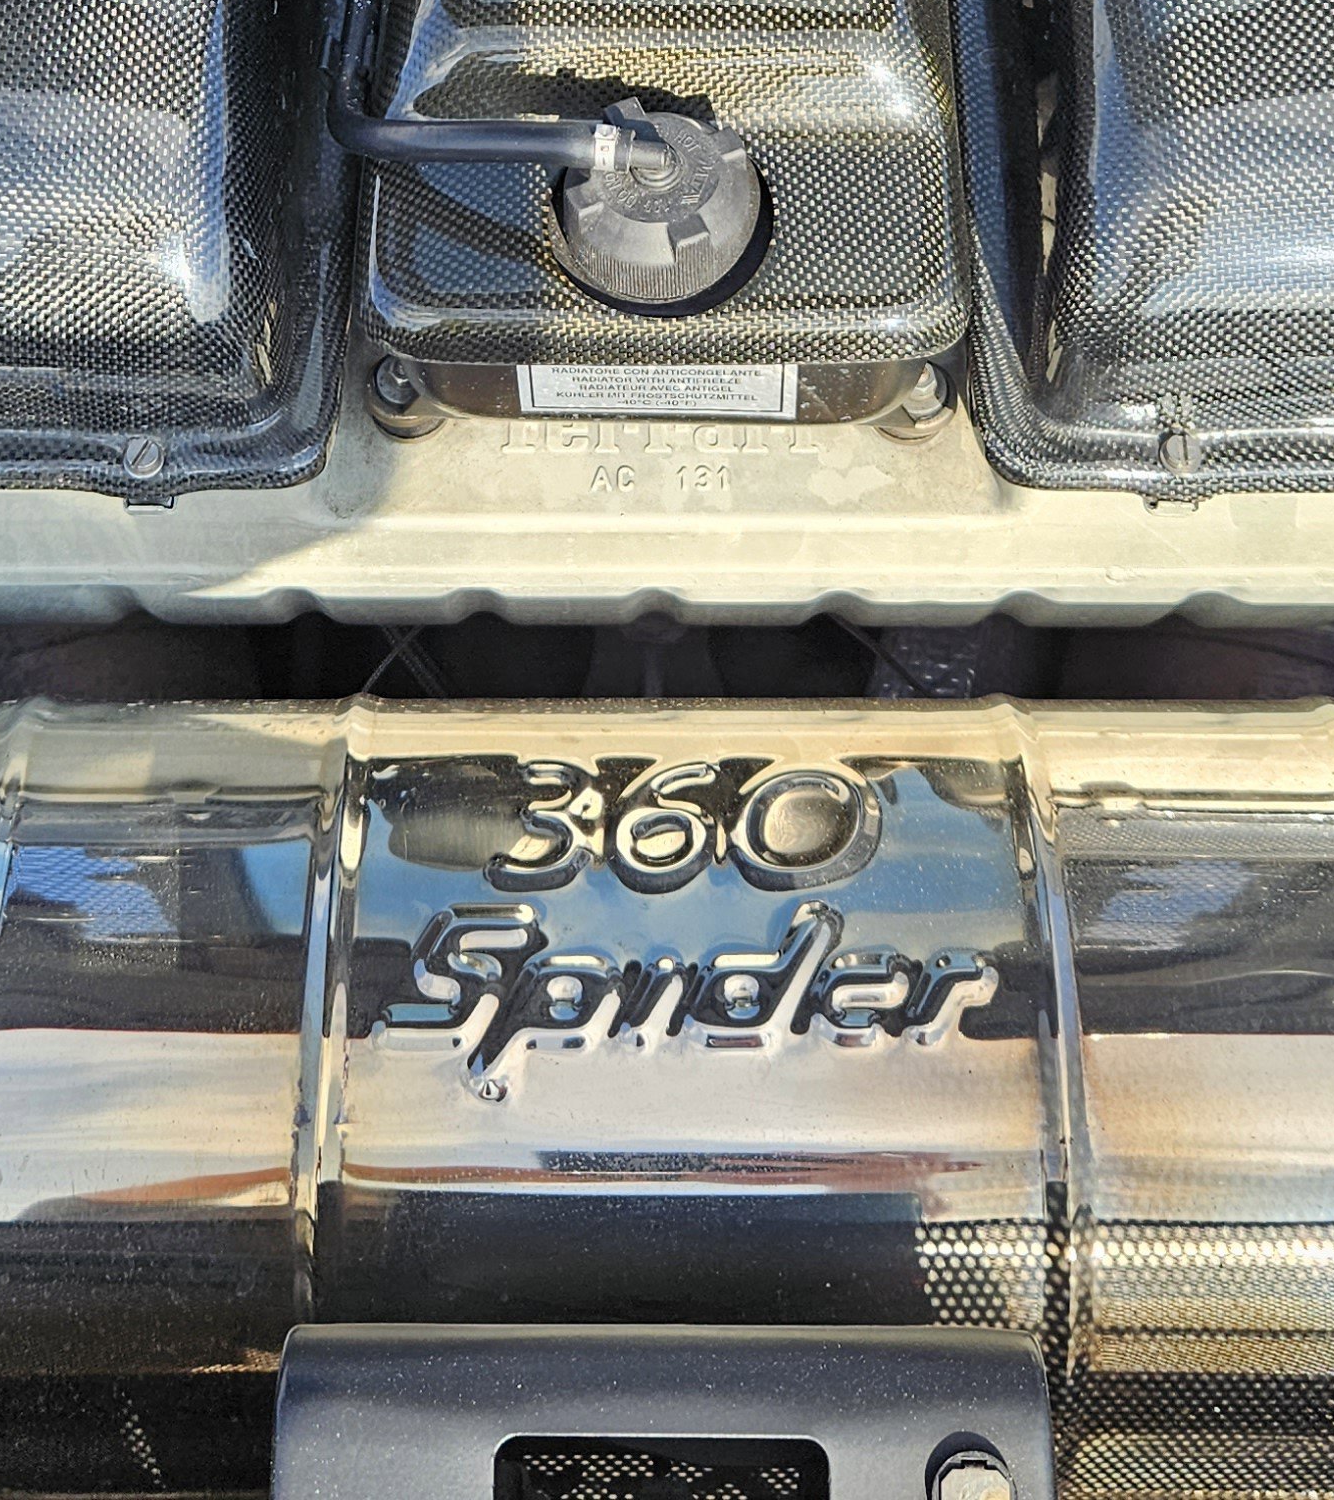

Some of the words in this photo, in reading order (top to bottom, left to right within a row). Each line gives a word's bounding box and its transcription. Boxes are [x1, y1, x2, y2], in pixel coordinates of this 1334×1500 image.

[551, 367, 620, 375] RADIATORE
[653, 369, 762, 377] ANTICONGELANTE
[669, 377, 742, 385] ANTIFREEZE
[591, 465, 635, 492] AC
[676, 465, 730, 492] 131
[485, 760, 881, 894] 360
[373, 900, 1001, 1101] Spider
